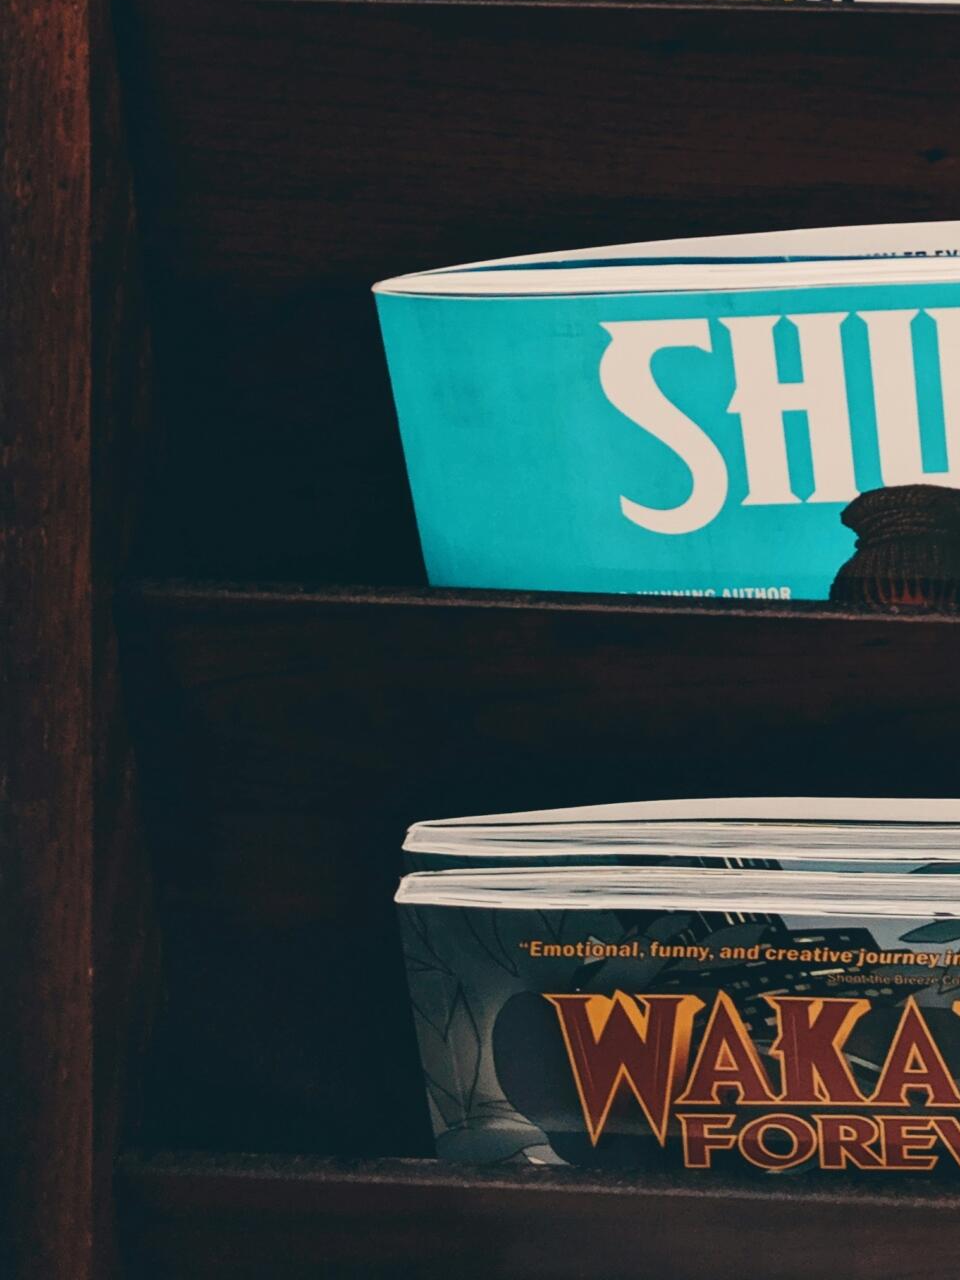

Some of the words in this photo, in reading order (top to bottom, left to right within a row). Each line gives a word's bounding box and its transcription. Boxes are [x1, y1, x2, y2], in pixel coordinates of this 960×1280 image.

[650, 941, 714, 962] funny,
[720, 944, 760, 961] and
[765, 945, 854, 963] creative
[857, 948, 942, 969] journey
